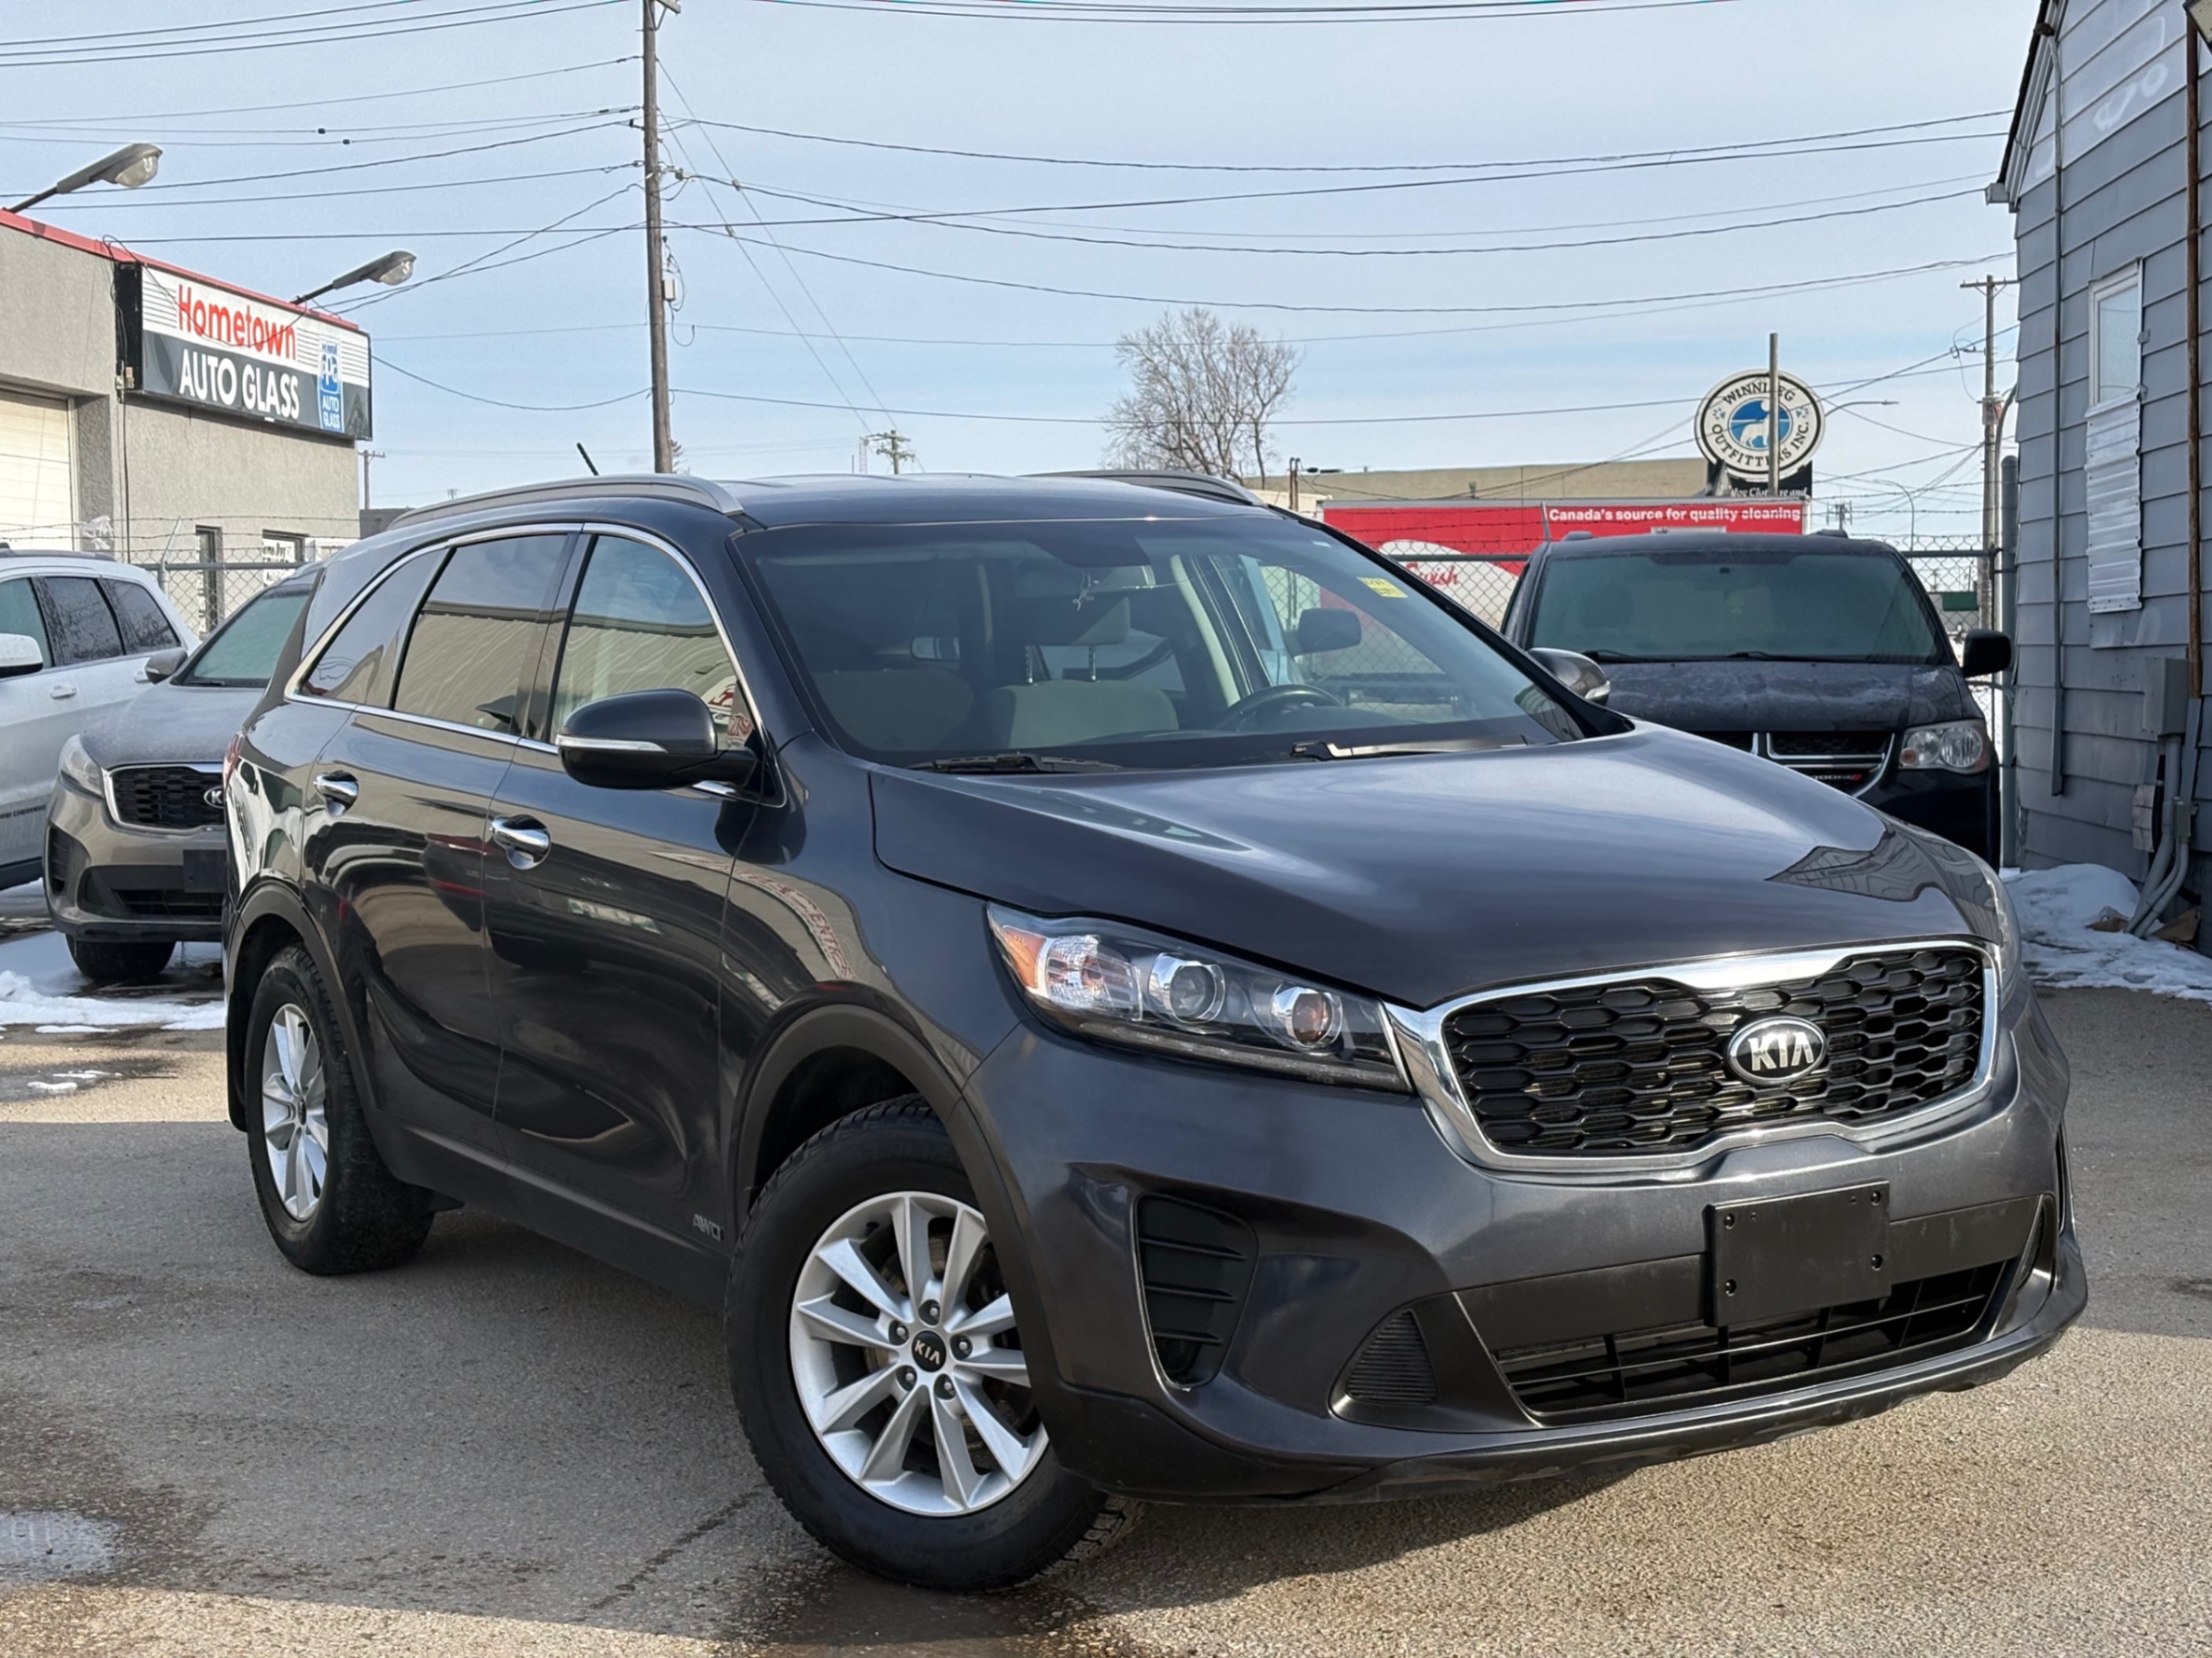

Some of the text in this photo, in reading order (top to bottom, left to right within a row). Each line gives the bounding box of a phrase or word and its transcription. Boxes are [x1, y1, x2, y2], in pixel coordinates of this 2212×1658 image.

[179, 284, 296, 361] Hometown
[179, 348, 300, 420] AUTO GLASS
[1723, 381, 1796, 405] WINNIEG
[323, 395, 339, 413] AUTO
[323, 411, 340, 429] GLASS
[1712, 421, 1809, 467] OUTFITTS INC.
[1549, 507, 1801, 522] Canada's source for quality cleaning
[1748, 1031, 1814, 1071] KIA
[693, 1213, 721, 1241] AWD
[915, 1339, 940, 1365] KIA
